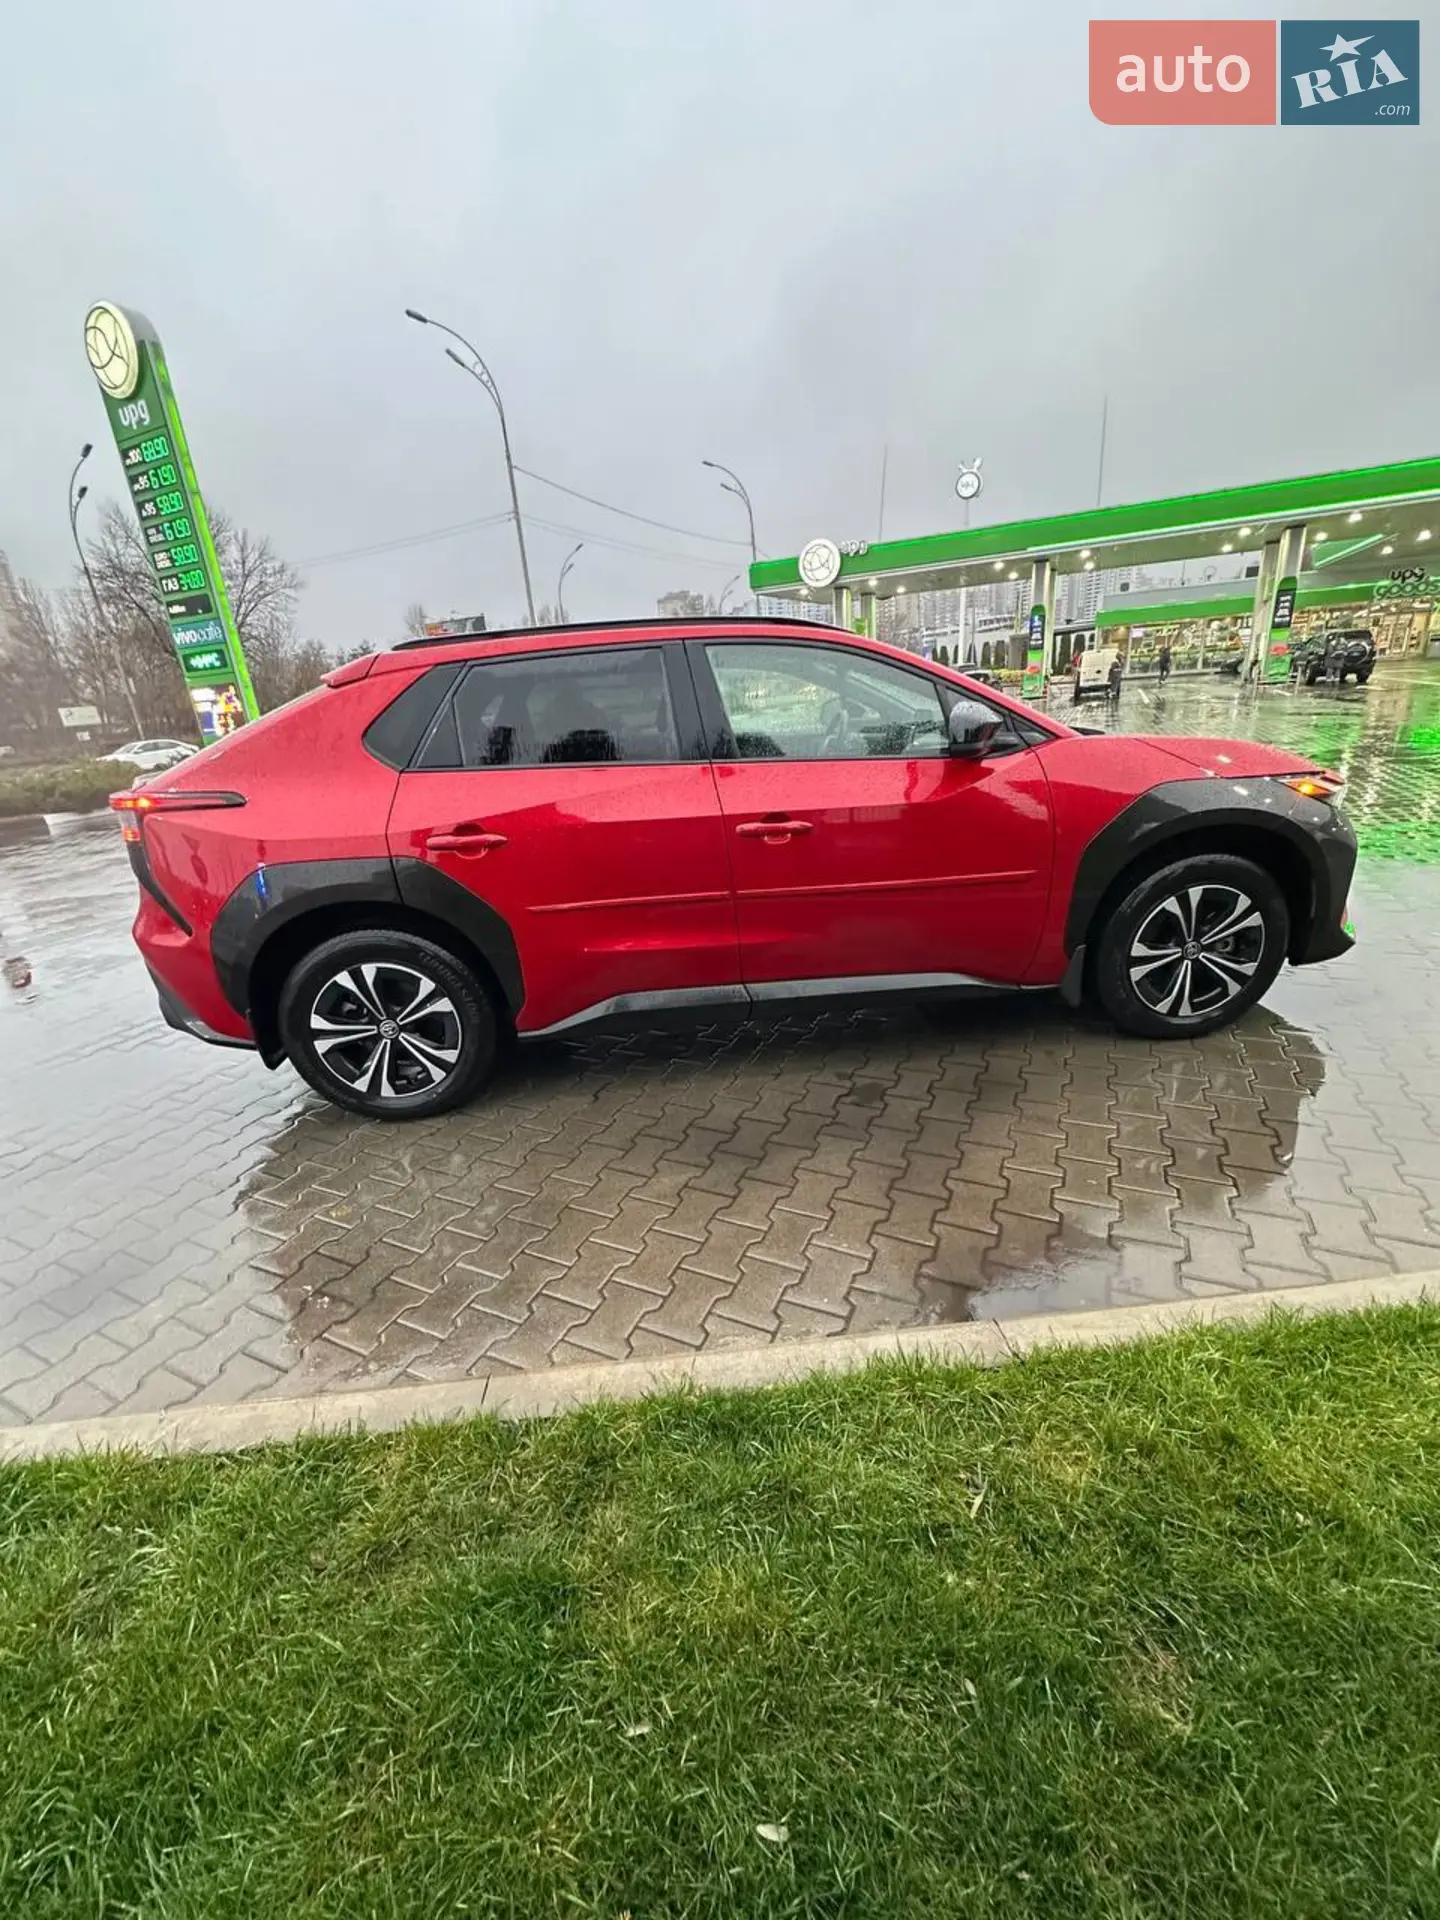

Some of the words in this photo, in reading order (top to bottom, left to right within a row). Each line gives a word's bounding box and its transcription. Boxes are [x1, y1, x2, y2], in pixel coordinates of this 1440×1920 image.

[118, 399, 150, 430] upg
[1391, 567, 1425, 584] upg
[161, 577, 180, 593] ГАЗ
